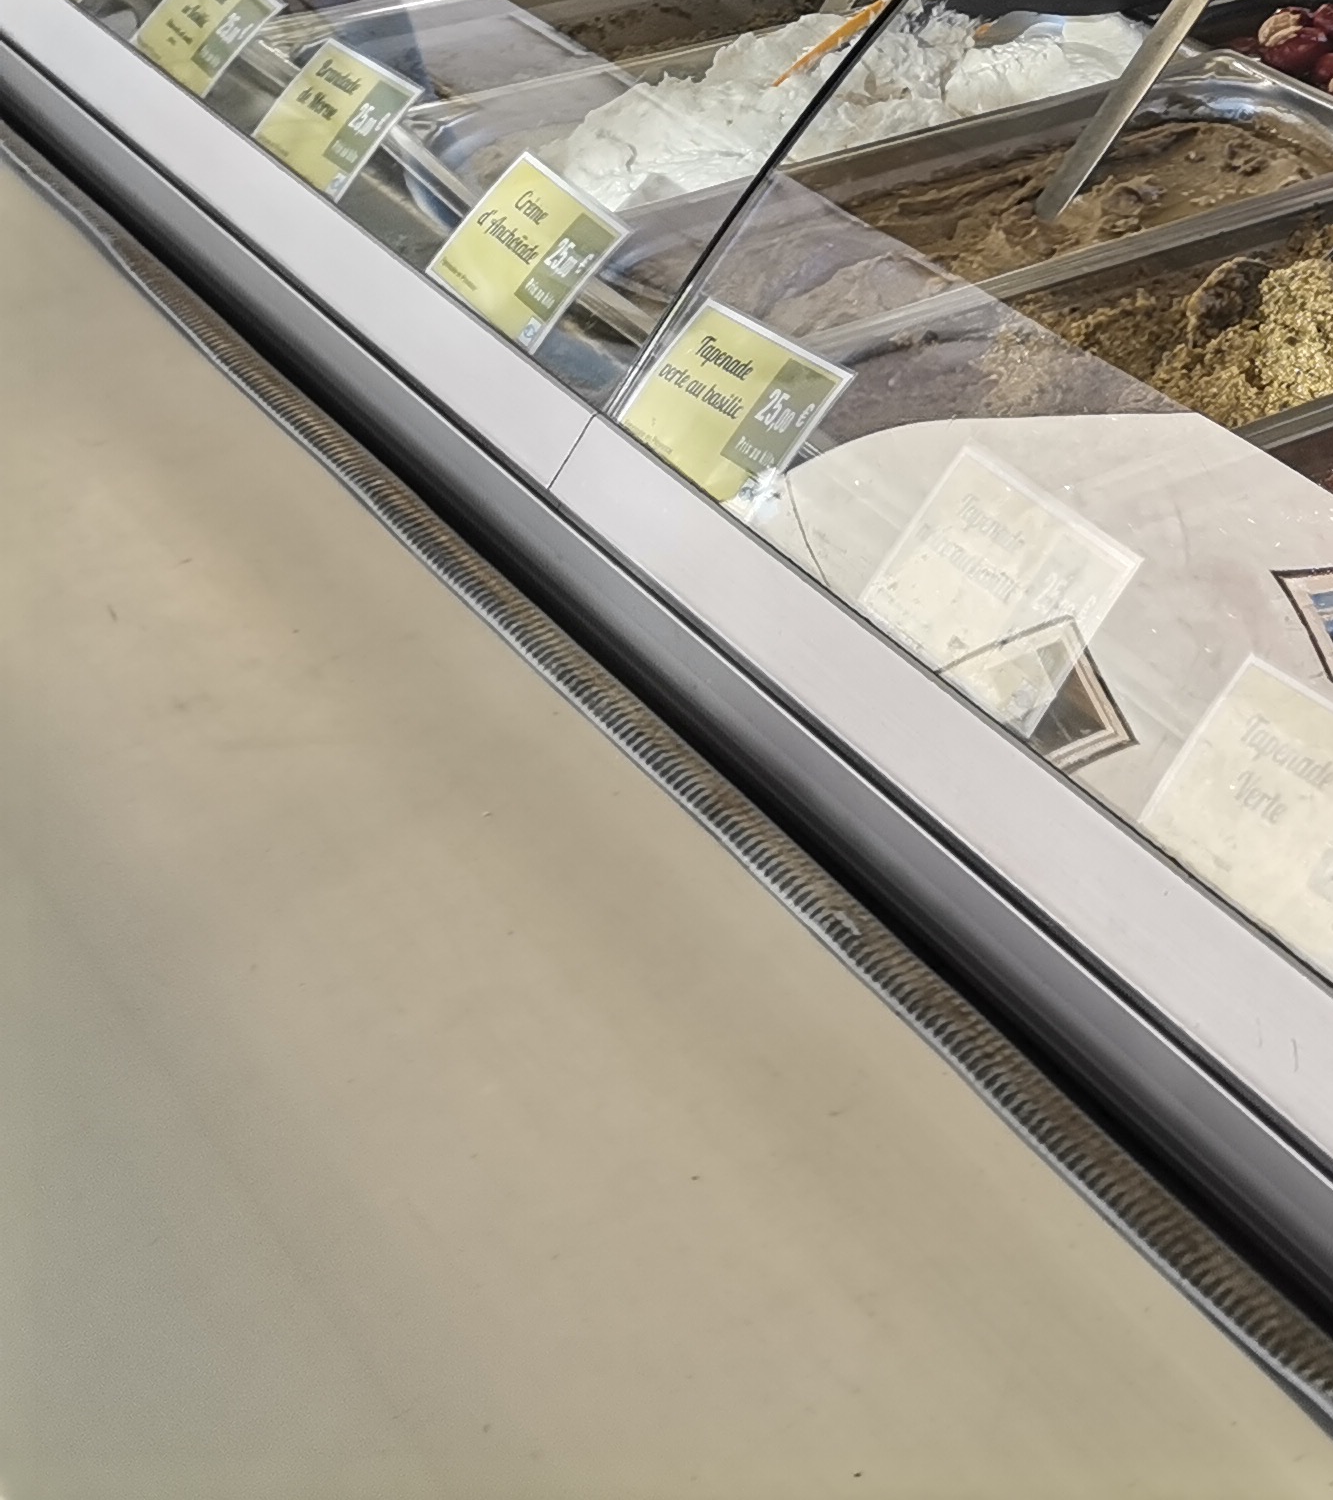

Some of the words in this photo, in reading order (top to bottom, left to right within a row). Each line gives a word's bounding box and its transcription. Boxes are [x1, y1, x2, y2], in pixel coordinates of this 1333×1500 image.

[513, 188, 551, 227] Crème
[575, 252, 595, 276] €
[658, 362, 690, 390] verte
[685, 379, 705, 401] au
[702, 383, 744, 421] basilic
[695, 334, 755, 381] Tapenade
[754, 388, 796, 435] 25,00
[794, 403, 815, 429] €
[735, 435, 753, 454] Prix
[1229, 769, 1289, 826] Verte
